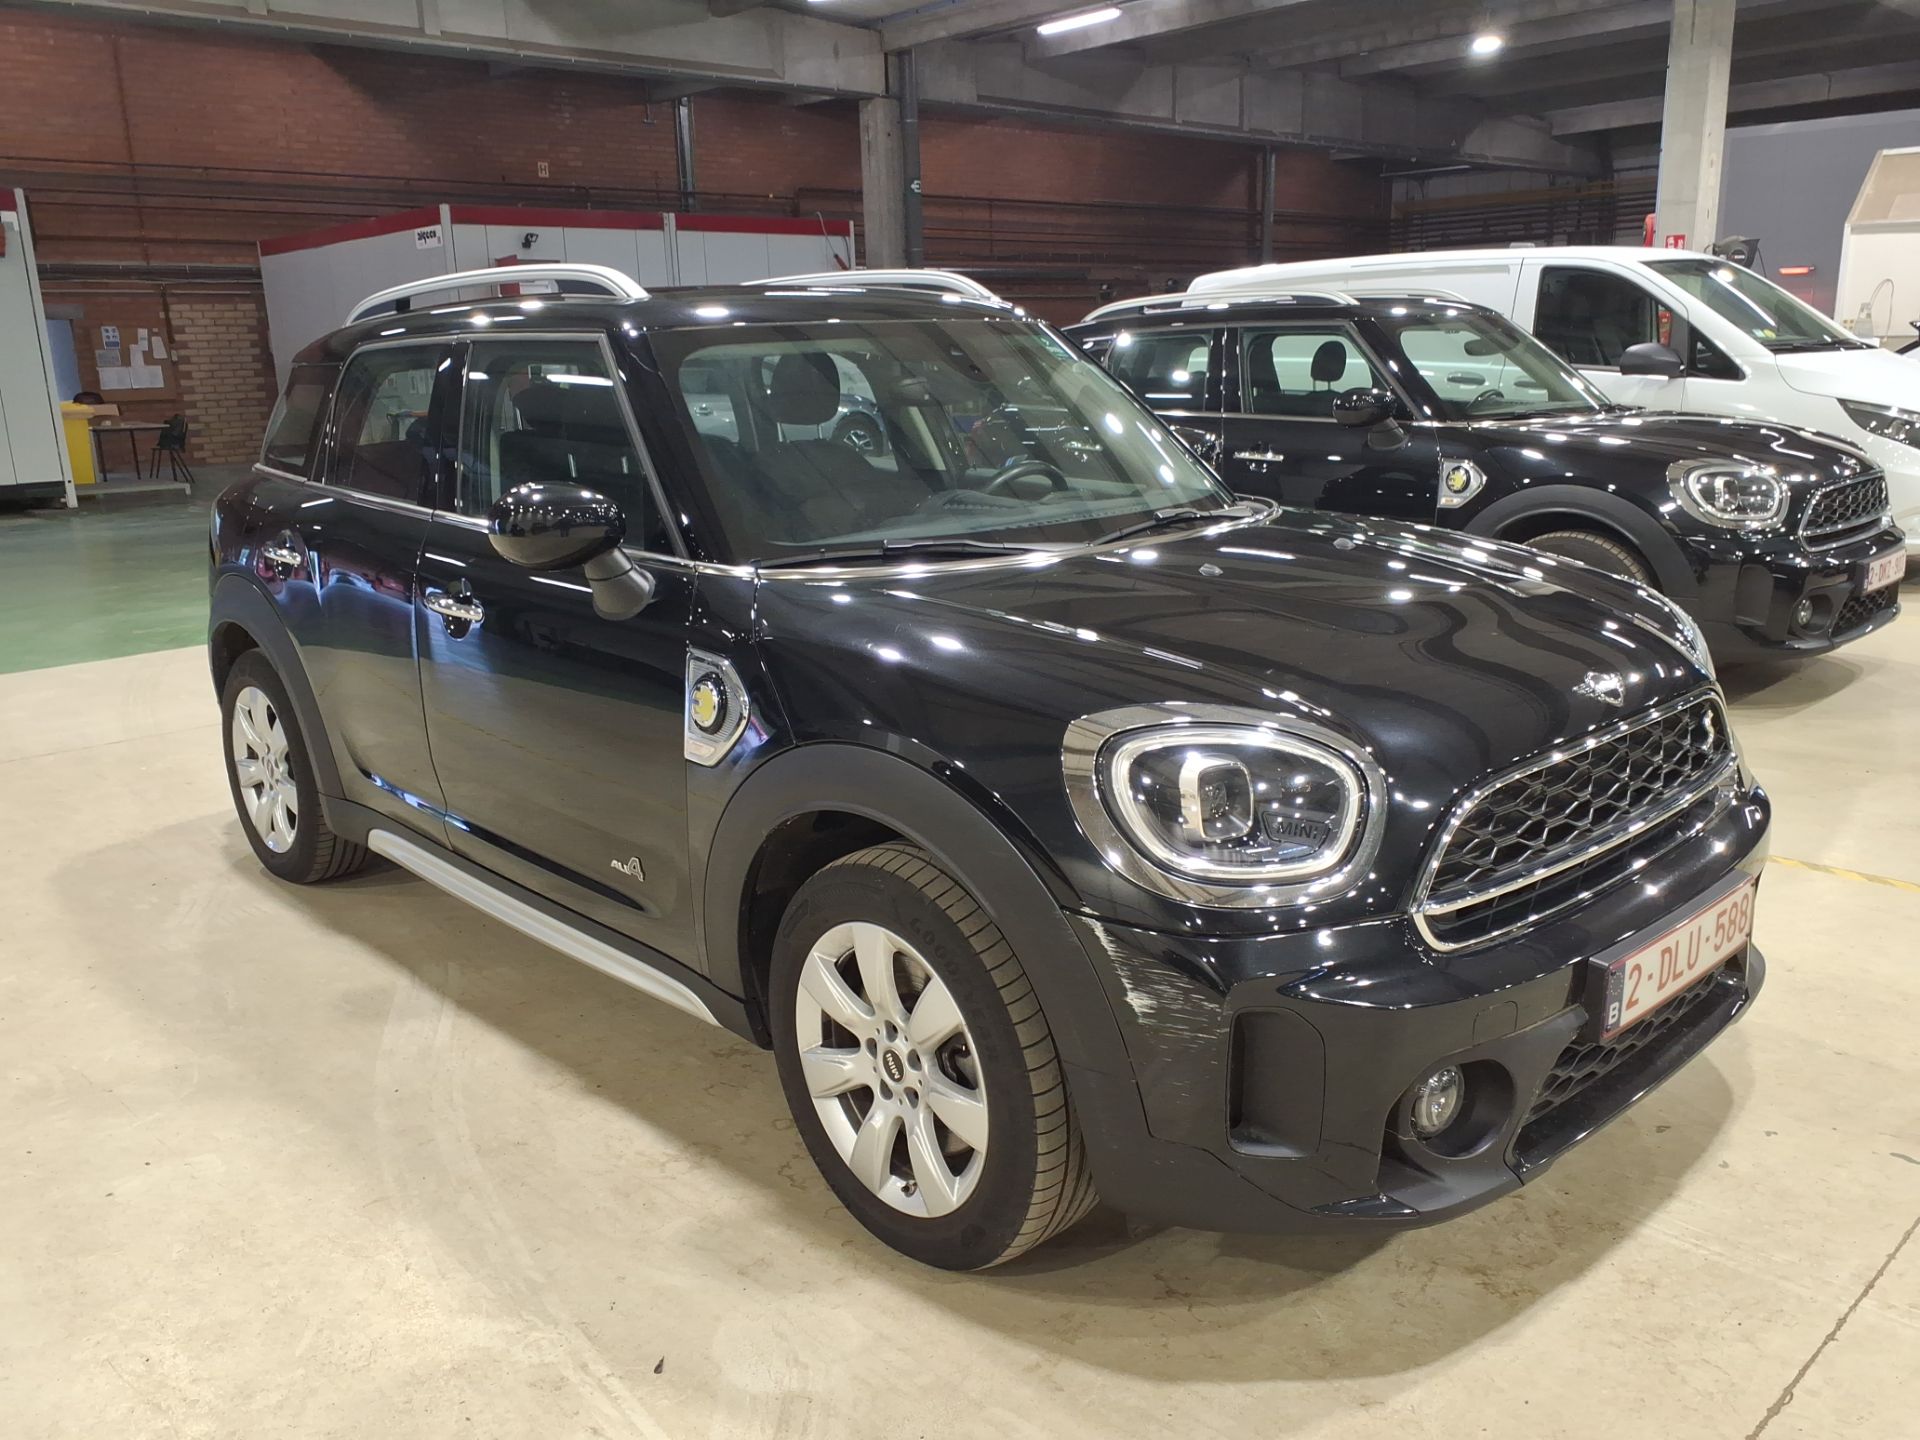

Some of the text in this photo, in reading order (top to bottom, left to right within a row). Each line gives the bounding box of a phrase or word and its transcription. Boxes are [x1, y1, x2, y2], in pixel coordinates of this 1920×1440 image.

[1276, 820, 1318, 840] MINI
[1625, 893, 1750, 1011] 2-DLU-588
[1608, 1002, 1620, 1025] B
[885, 1053, 901, 1079] MINI
